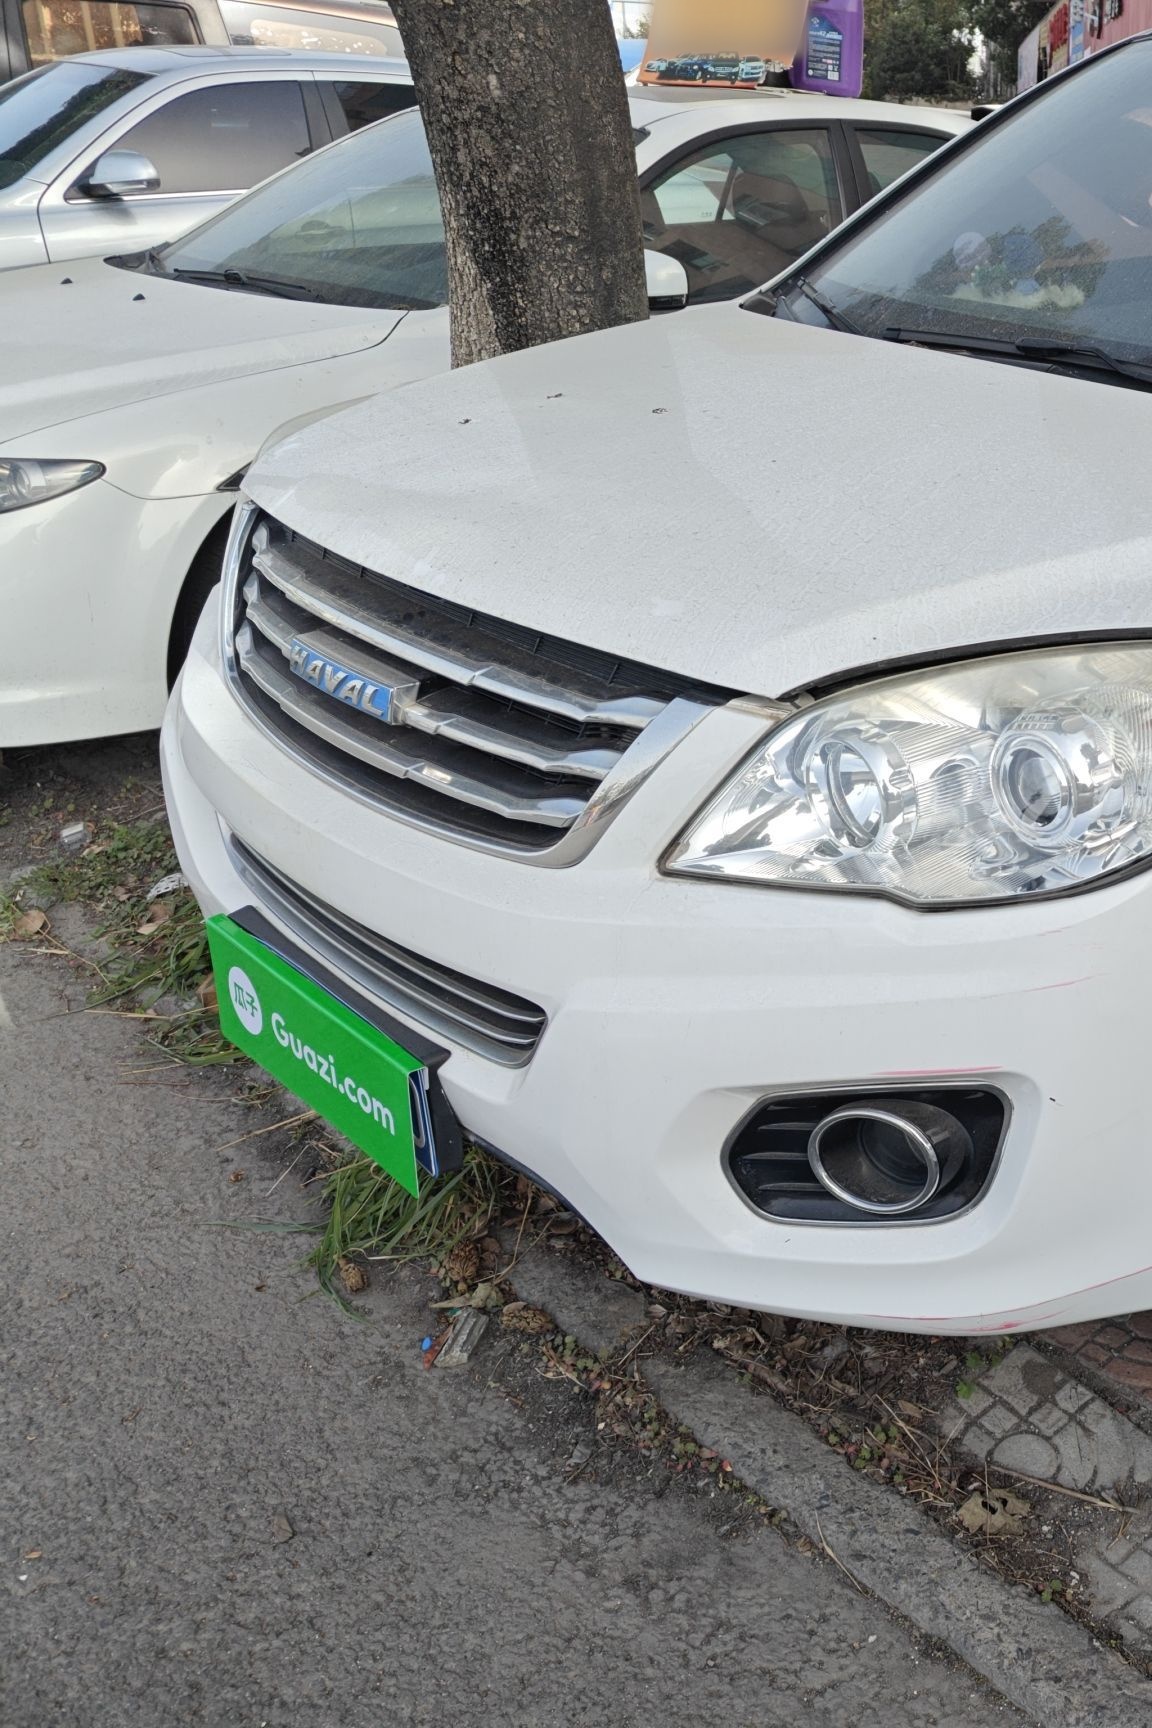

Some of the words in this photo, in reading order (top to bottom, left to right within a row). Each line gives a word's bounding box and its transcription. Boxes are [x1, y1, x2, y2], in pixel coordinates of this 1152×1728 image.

[291, 645, 385, 717] HAVAL
[234, 981, 258, 1018] 瓜子
[271, 1012, 396, 1137] Guazi.com
